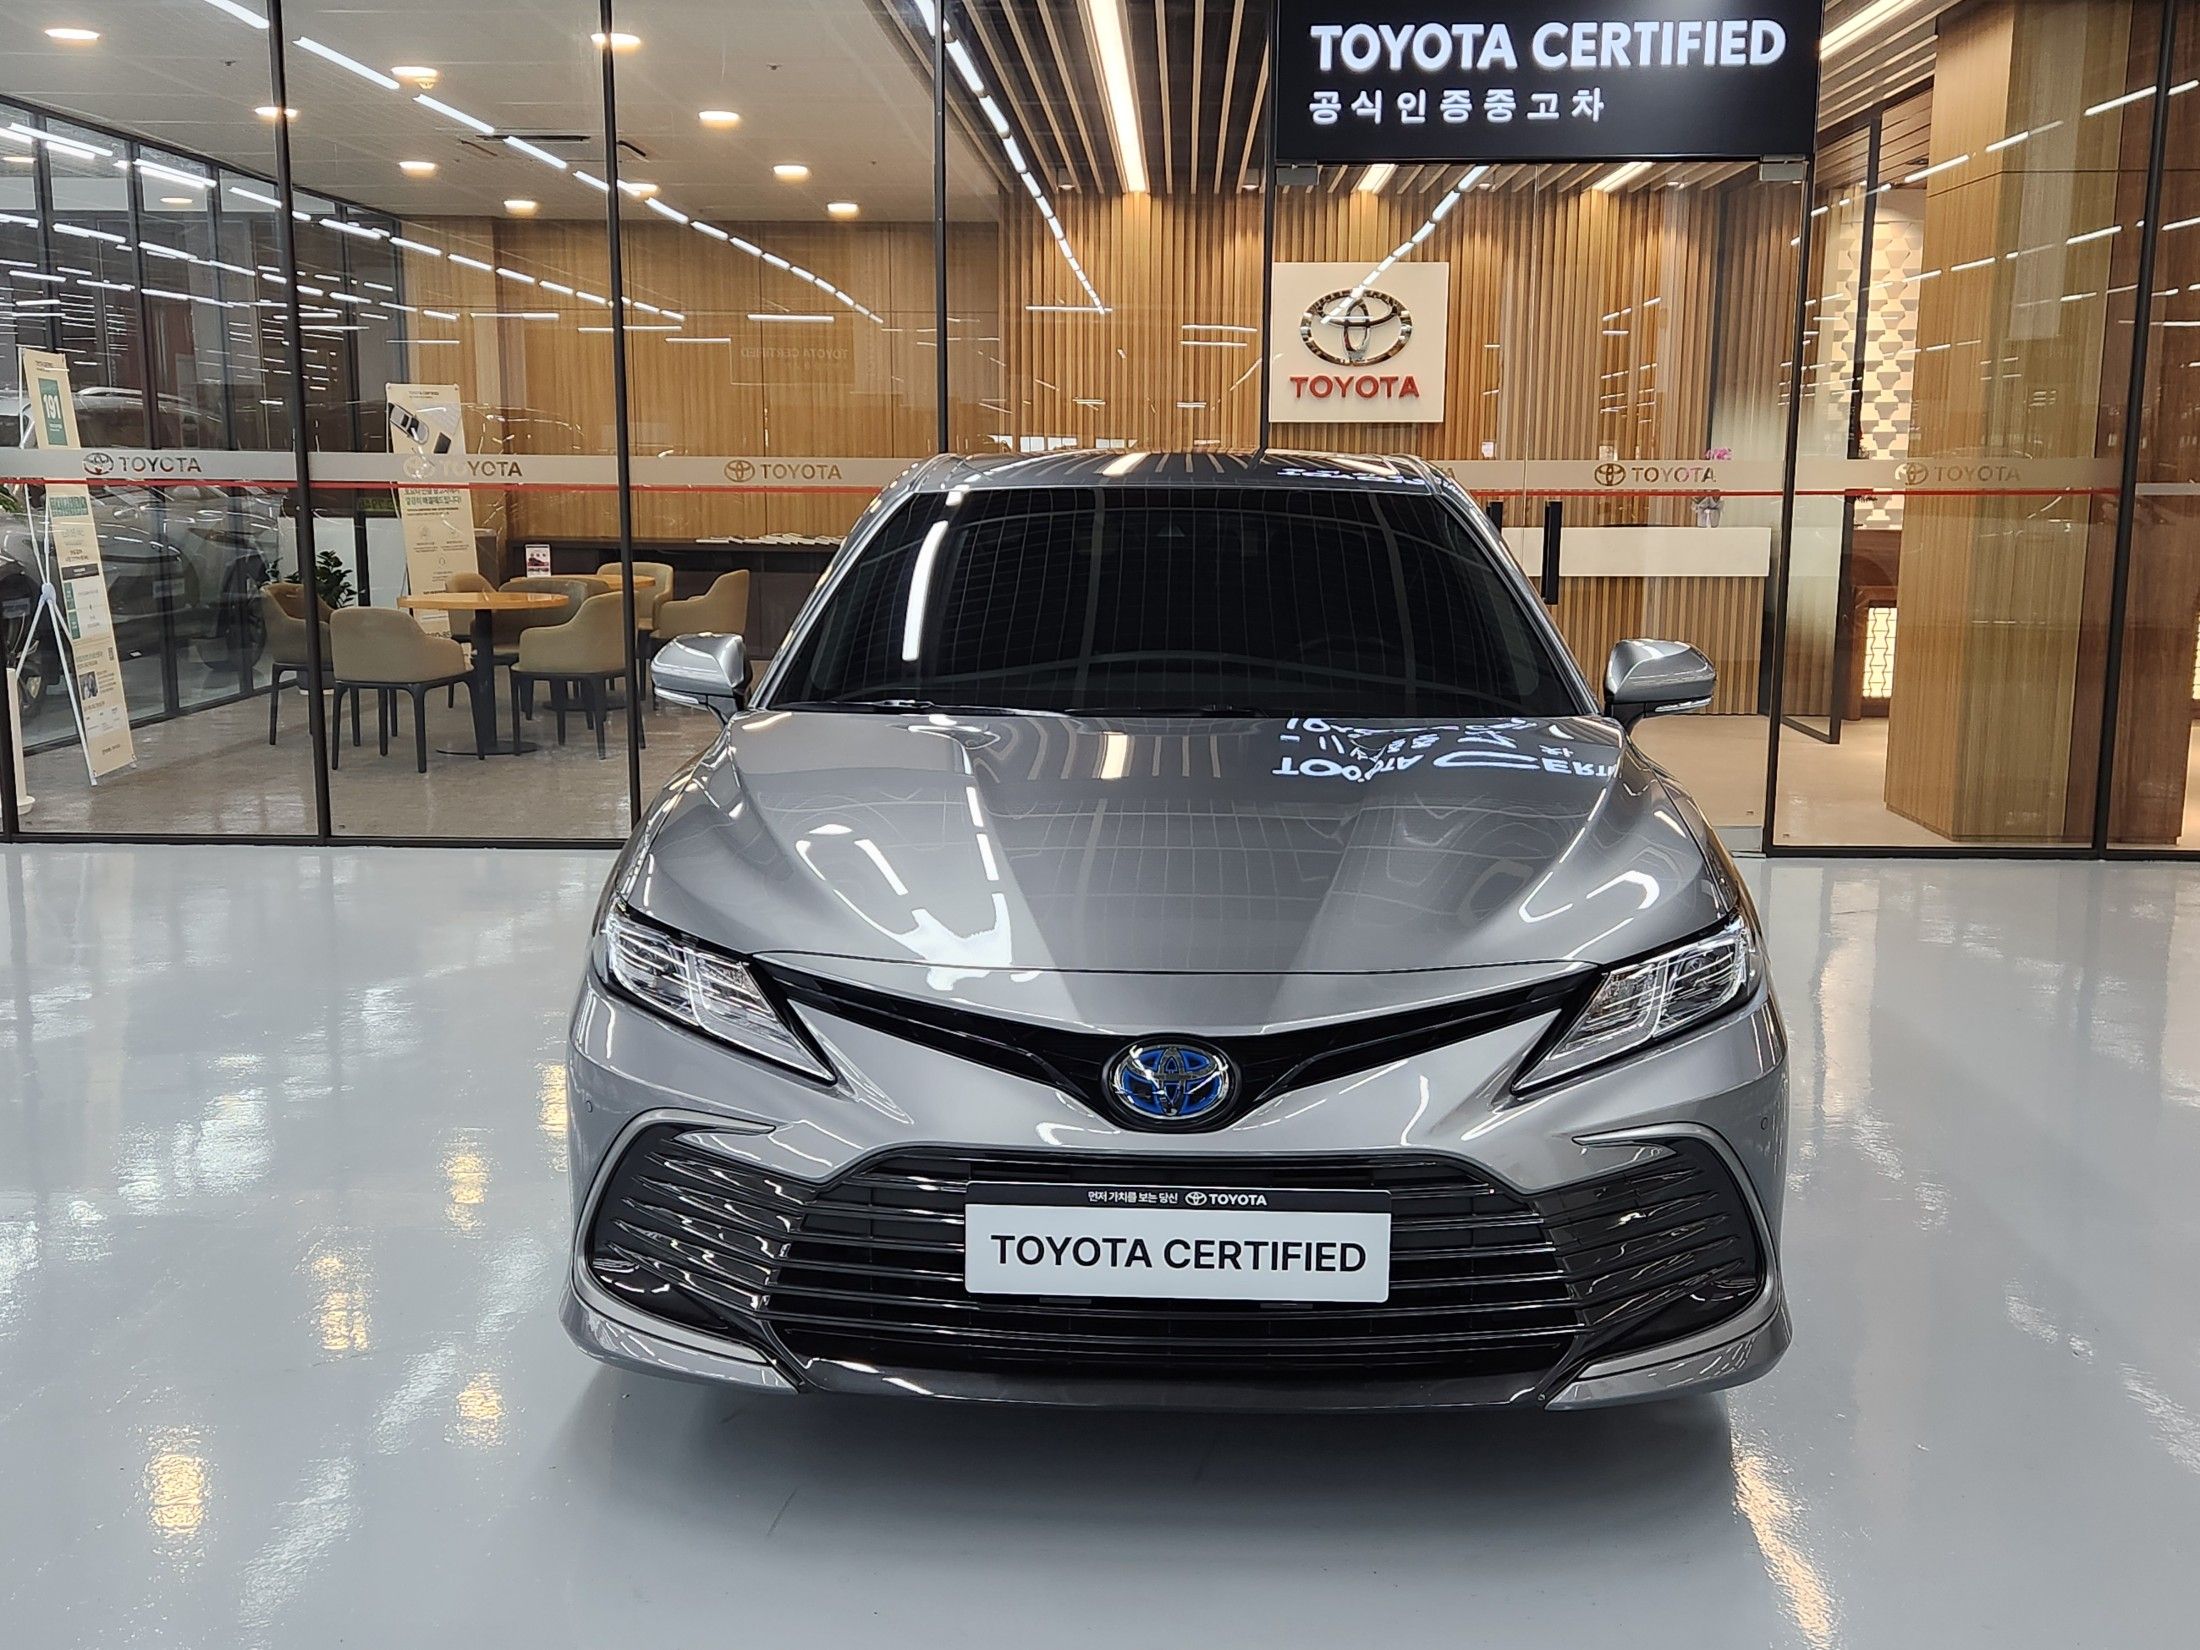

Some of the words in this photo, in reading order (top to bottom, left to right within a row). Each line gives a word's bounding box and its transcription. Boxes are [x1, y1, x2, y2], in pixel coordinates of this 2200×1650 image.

[1310, 22, 1519, 72] TOYOTA
[1532, 19, 1787, 68] CERTIFIED
[1289, 374, 1420, 399] TOYOTA
[43, 393, 62, 420] 191
[118, 456, 202, 473] TOYOTA
[760, 463, 842, 480] TOYOTA
[1631, 466, 1716, 483] TOYOTA
[1934, 465, 2020, 482] TOYOTA
[1087, 1190, 1107, 1203] 먼저
[1108, 1191, 1137, 1204] 가치를
[1138, 1192, 1158, 1204] 보는
[1158, 1192, 1179, 1205] 당신
[1208, 1193, 1268, 1206] TOYOTA
[990, 1234, 1153, 1269] TOYOTA
[1163, 1238, 1367, 1273] CERTIFIED
